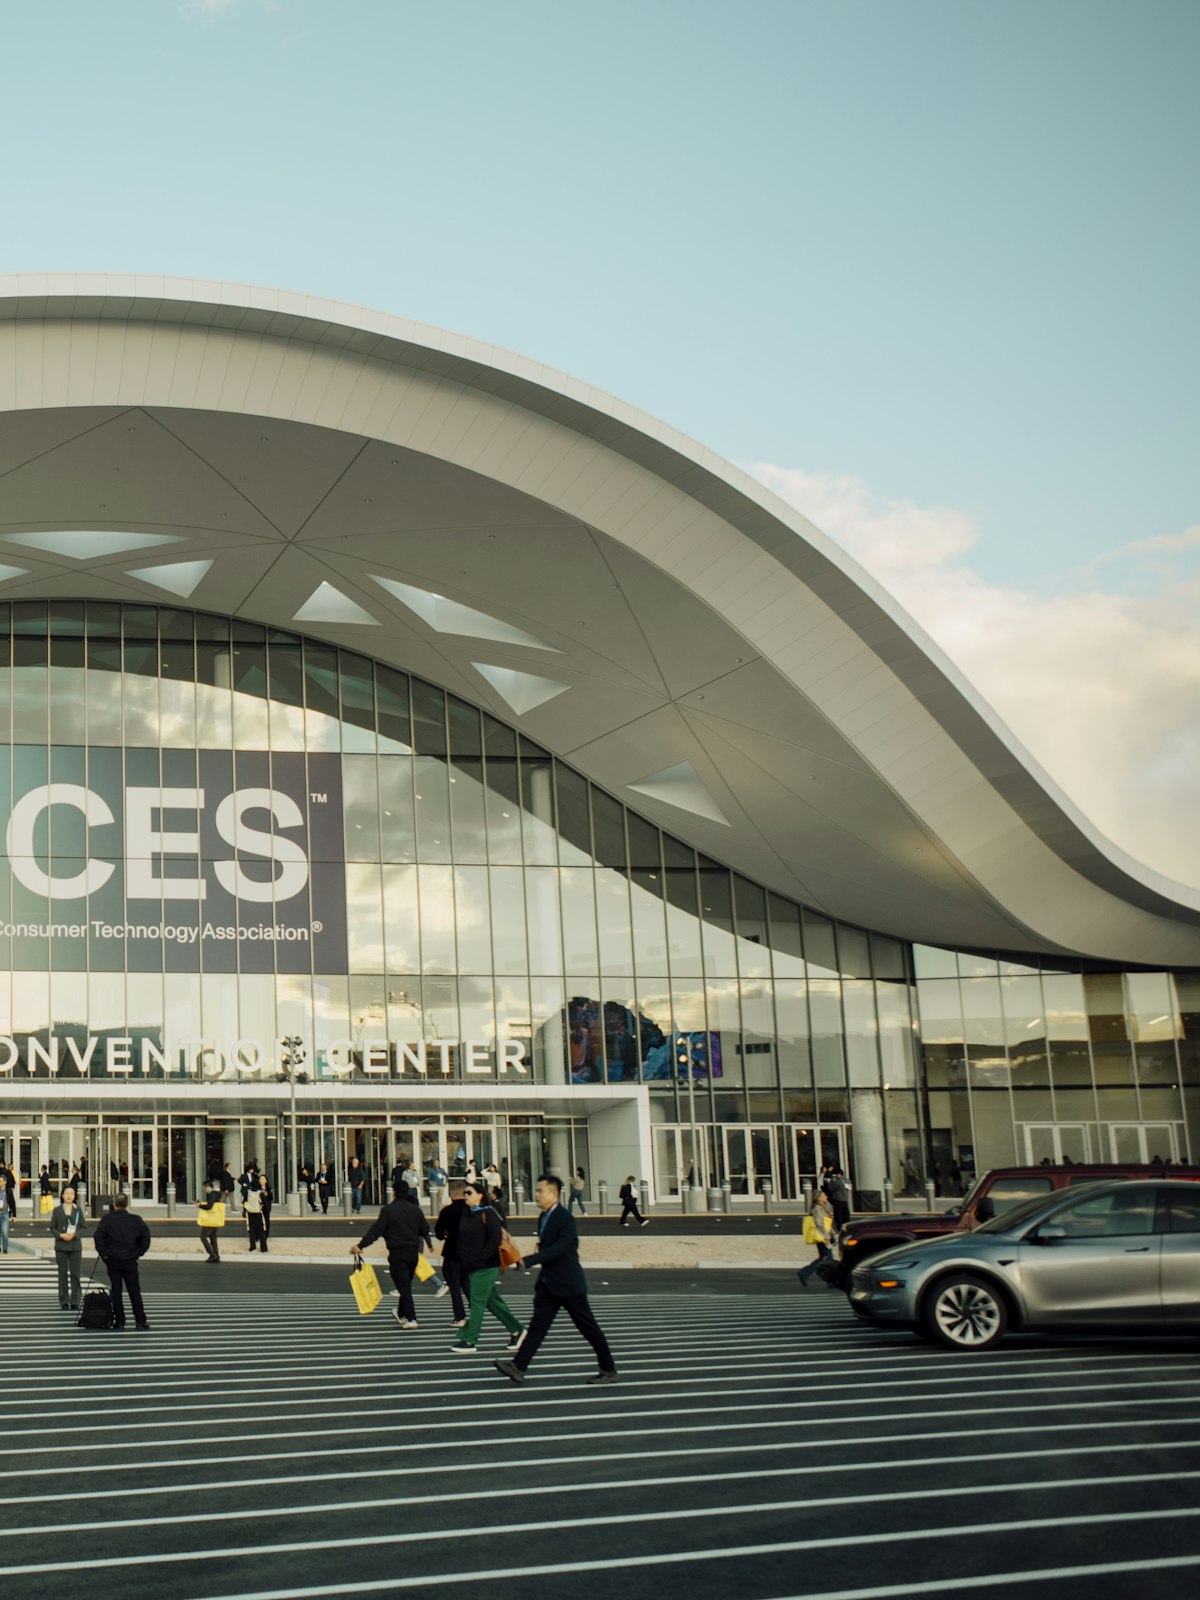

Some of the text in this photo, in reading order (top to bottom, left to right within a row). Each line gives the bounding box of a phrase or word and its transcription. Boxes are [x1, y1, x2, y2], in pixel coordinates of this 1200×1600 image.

[6, 783, 309, 902] CES
[91, 921, 199, 943] Technology
[325, 1039, 528, 1074] CENTER
